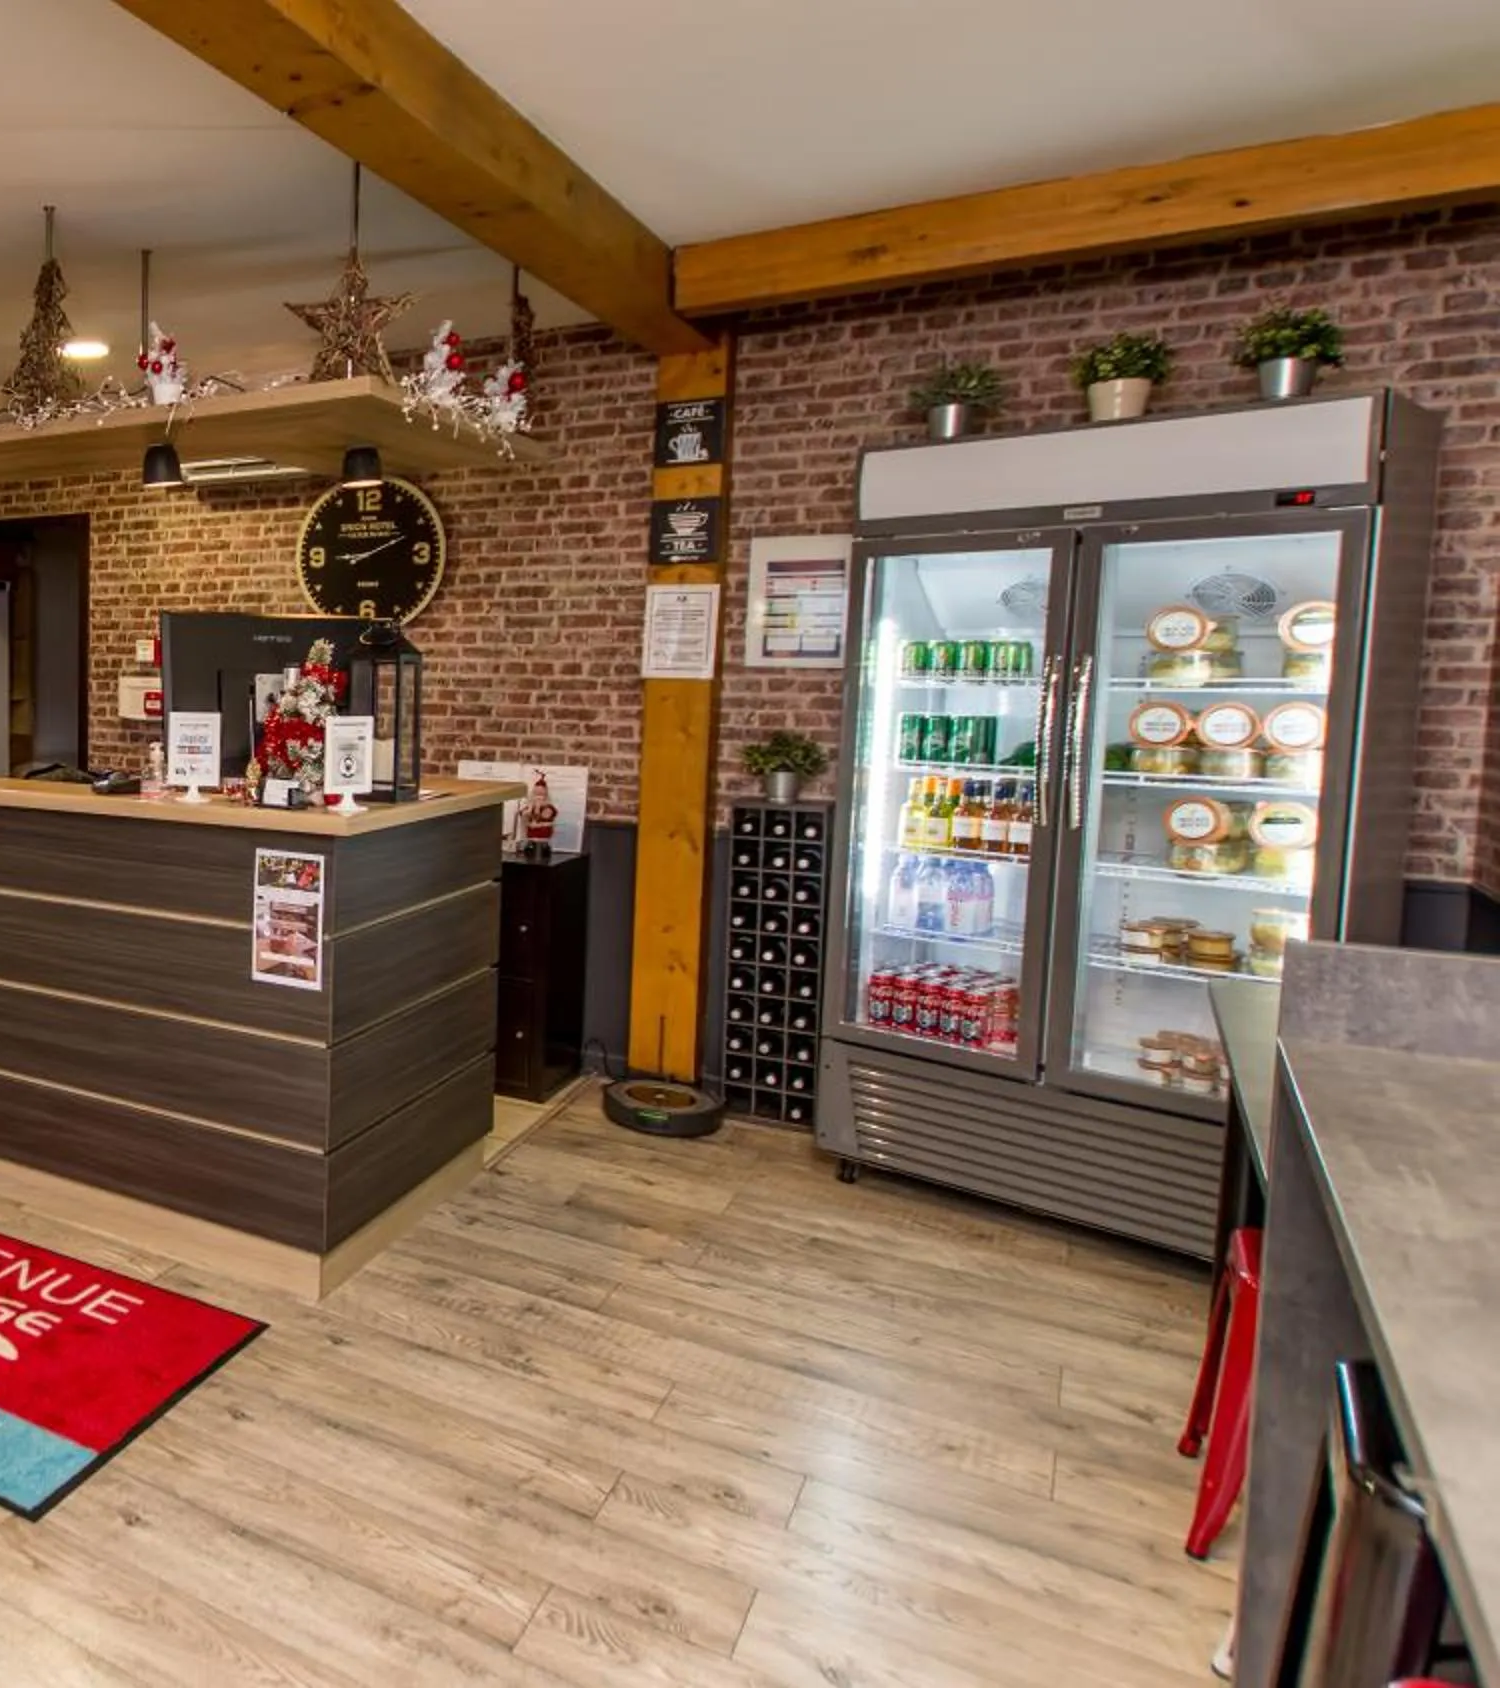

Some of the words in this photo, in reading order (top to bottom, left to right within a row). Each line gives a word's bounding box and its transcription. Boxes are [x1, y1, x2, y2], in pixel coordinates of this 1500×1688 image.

[355, 489, 382, 512] 12
[309, 547, 325, 569] 9
[412, 542, 431, 565] 3
[359, 600, 376, 619] 6
